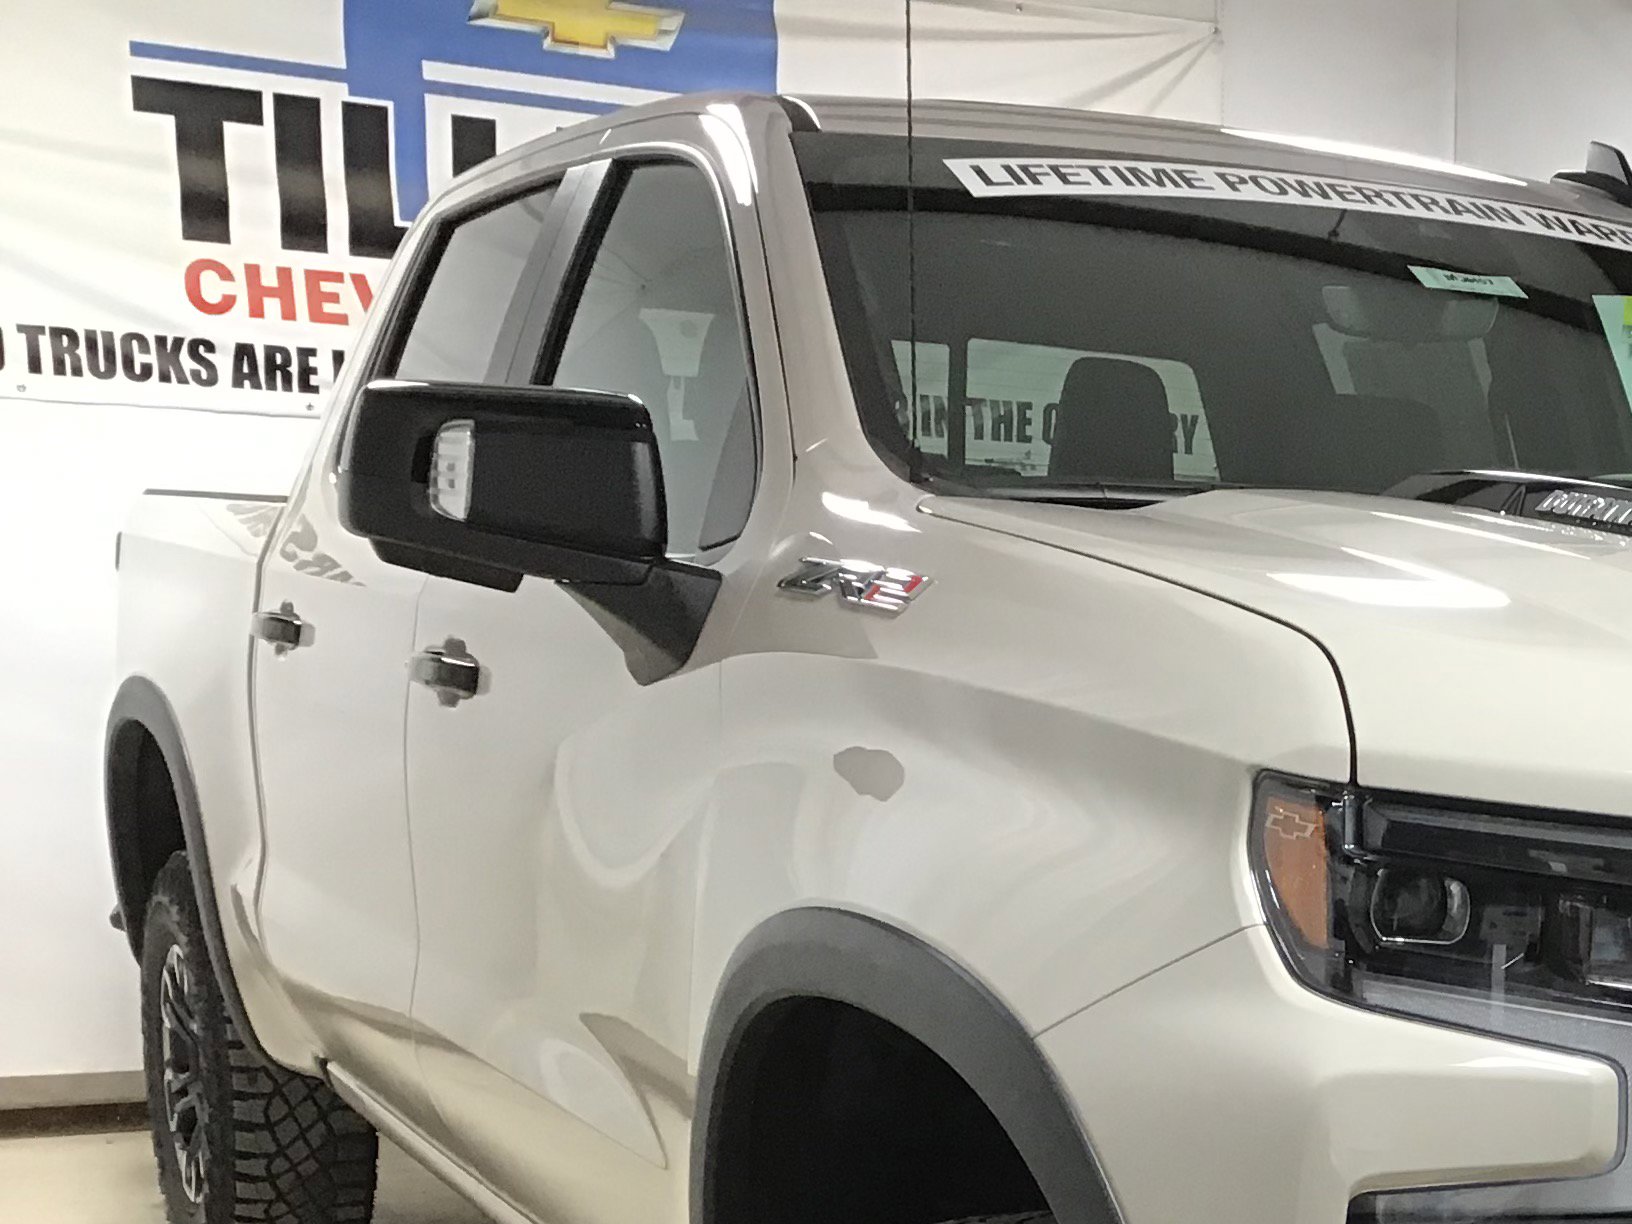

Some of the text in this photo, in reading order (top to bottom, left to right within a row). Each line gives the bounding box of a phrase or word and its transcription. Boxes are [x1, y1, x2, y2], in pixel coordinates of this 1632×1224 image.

[969, 164, 1214, 190] LIFETIME
[1215, 172, 1525, 226] POWERTRAIN
[16, 323, 219, 387] TRUCKS
[231, 342, 320, 394] ARE
[965, 398, 1032, 443] THE
